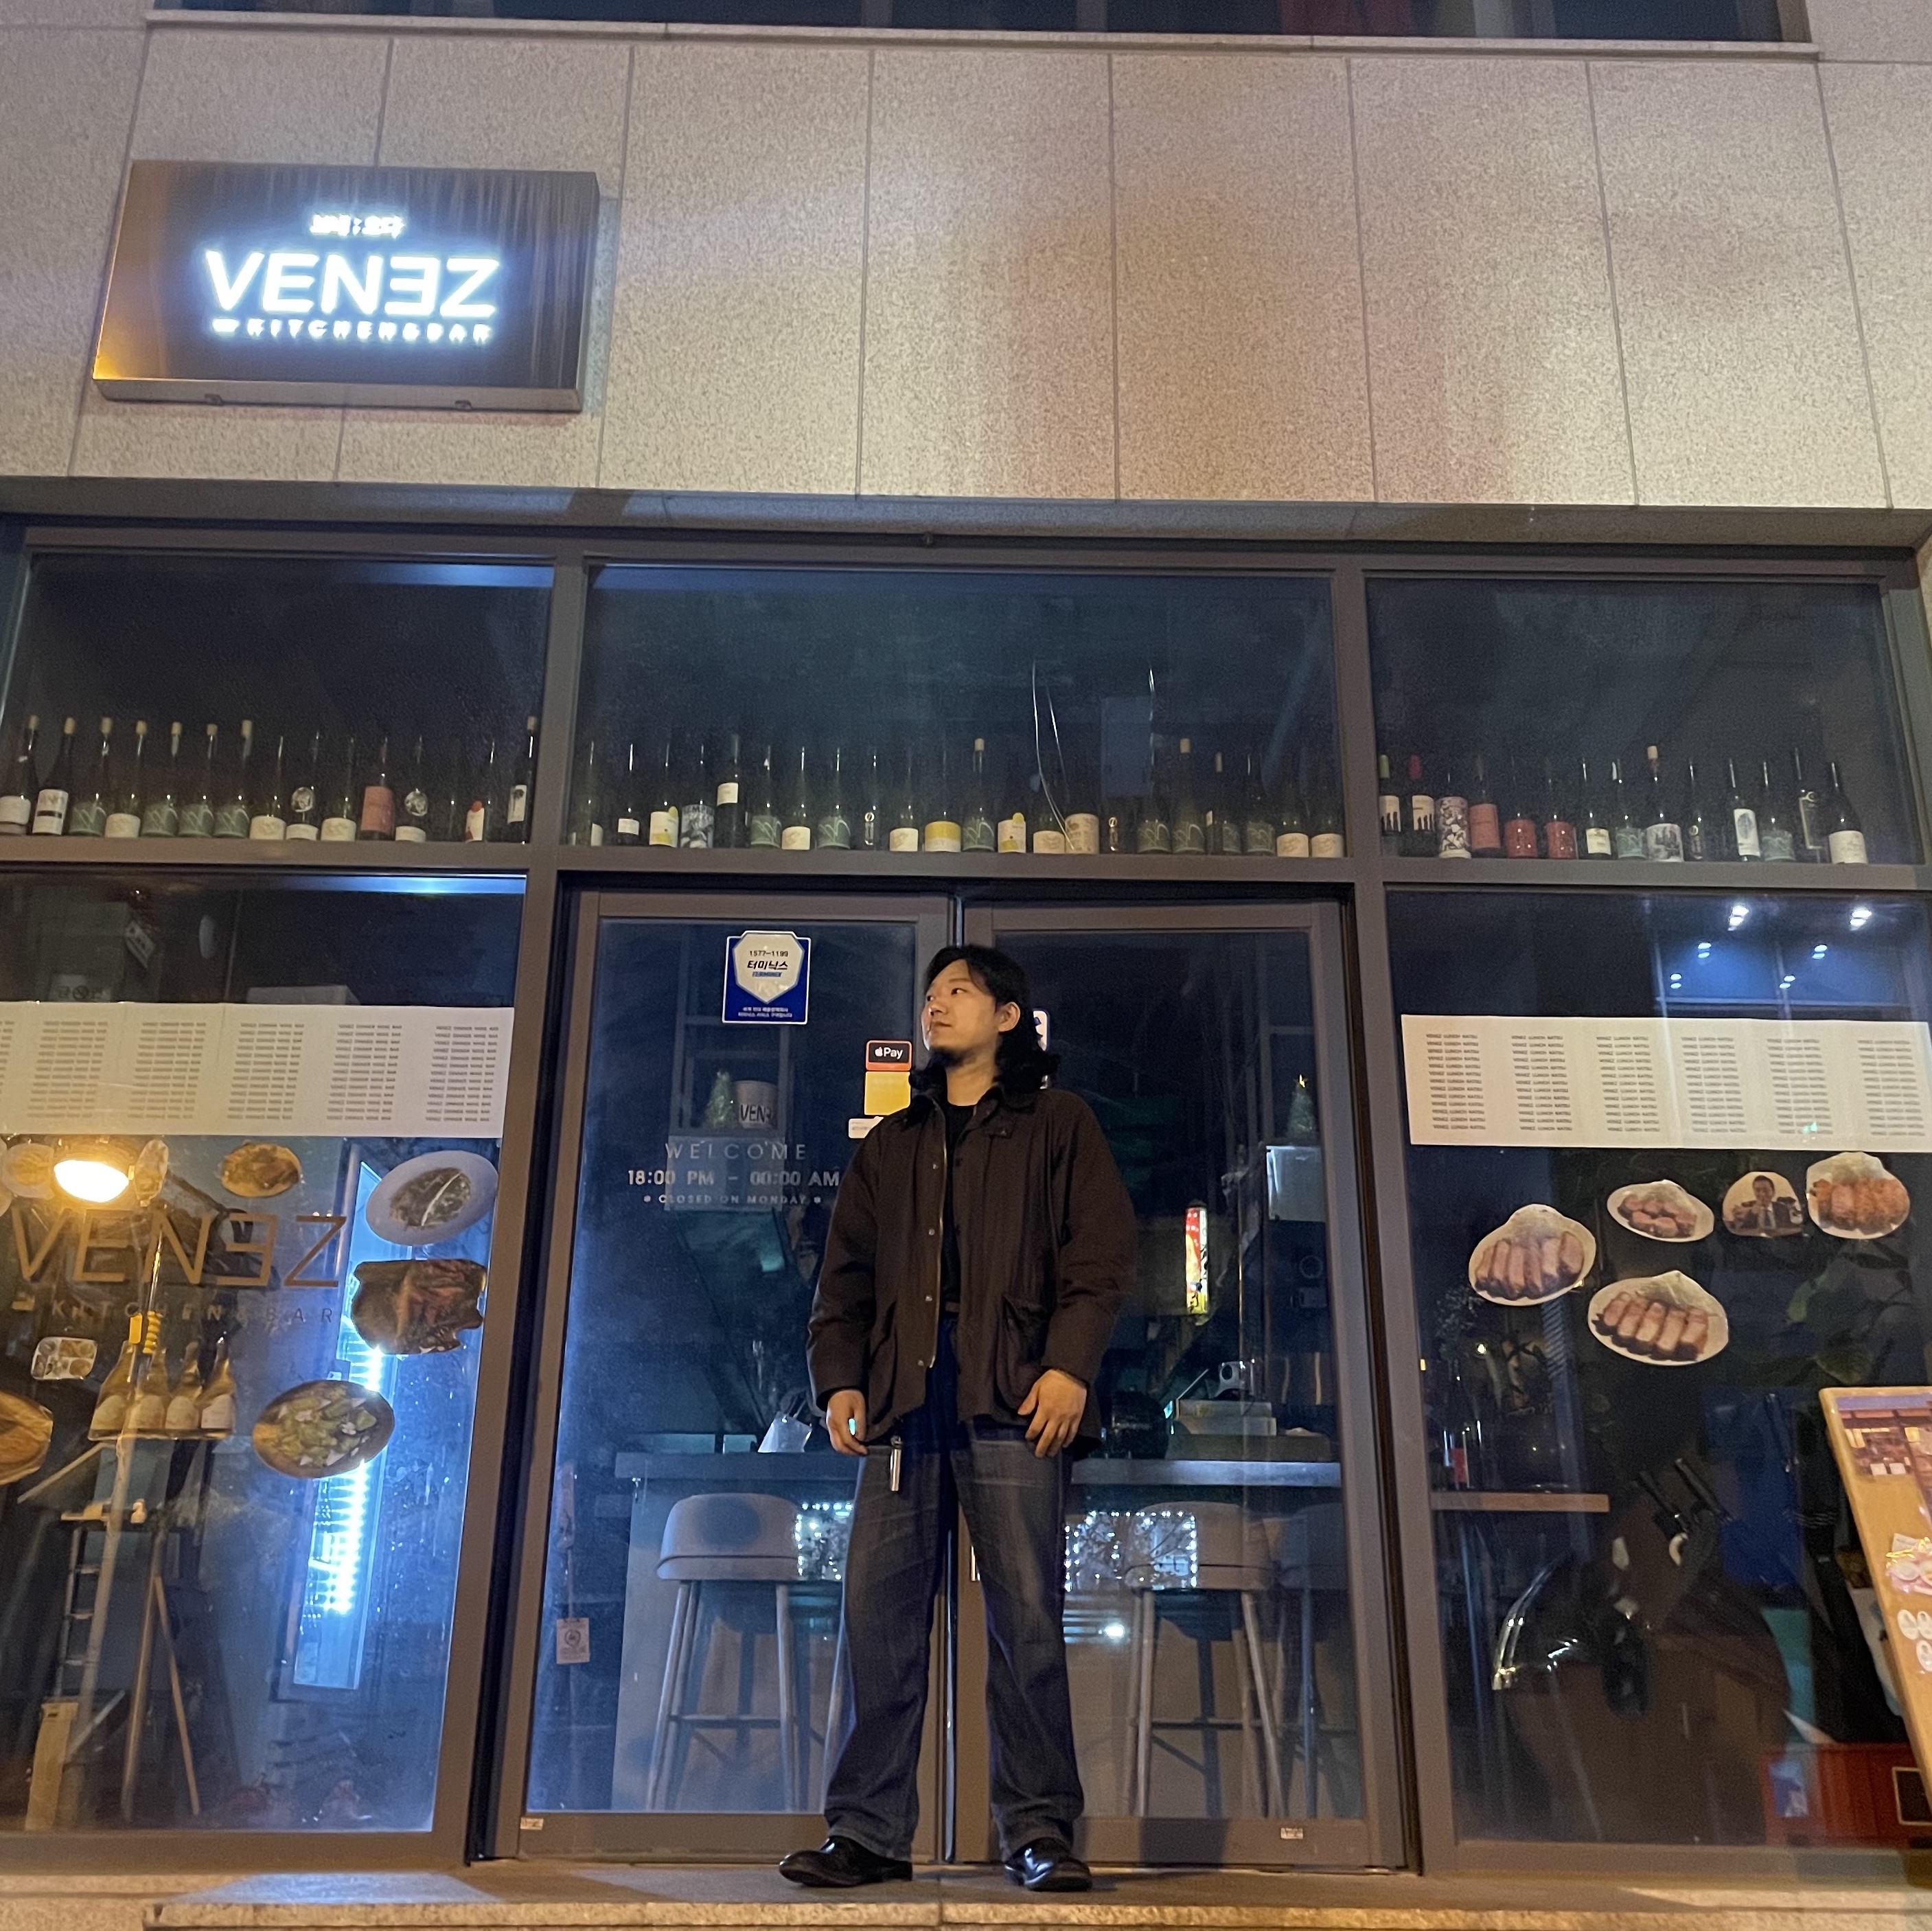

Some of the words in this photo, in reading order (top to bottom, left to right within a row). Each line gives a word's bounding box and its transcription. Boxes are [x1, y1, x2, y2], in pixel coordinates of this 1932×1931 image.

[747, 960, 788, 970] 터미닉스
[884, 1047, 904, 1059] Pay
[665, 1143, 806, 1160] WELCOME
[628, 1170, 676, 1186] 18:00
[687, 1170, 715, 1186] PM
[750, 1171, 801, 1186] 00:00
[808, 1171, 840, 1186] AM
[658, 1194, 712, 1204] CLOSED
[722, 1195, 739, 1204] ON
[747, 1195, 807, 1205] MONDAY
